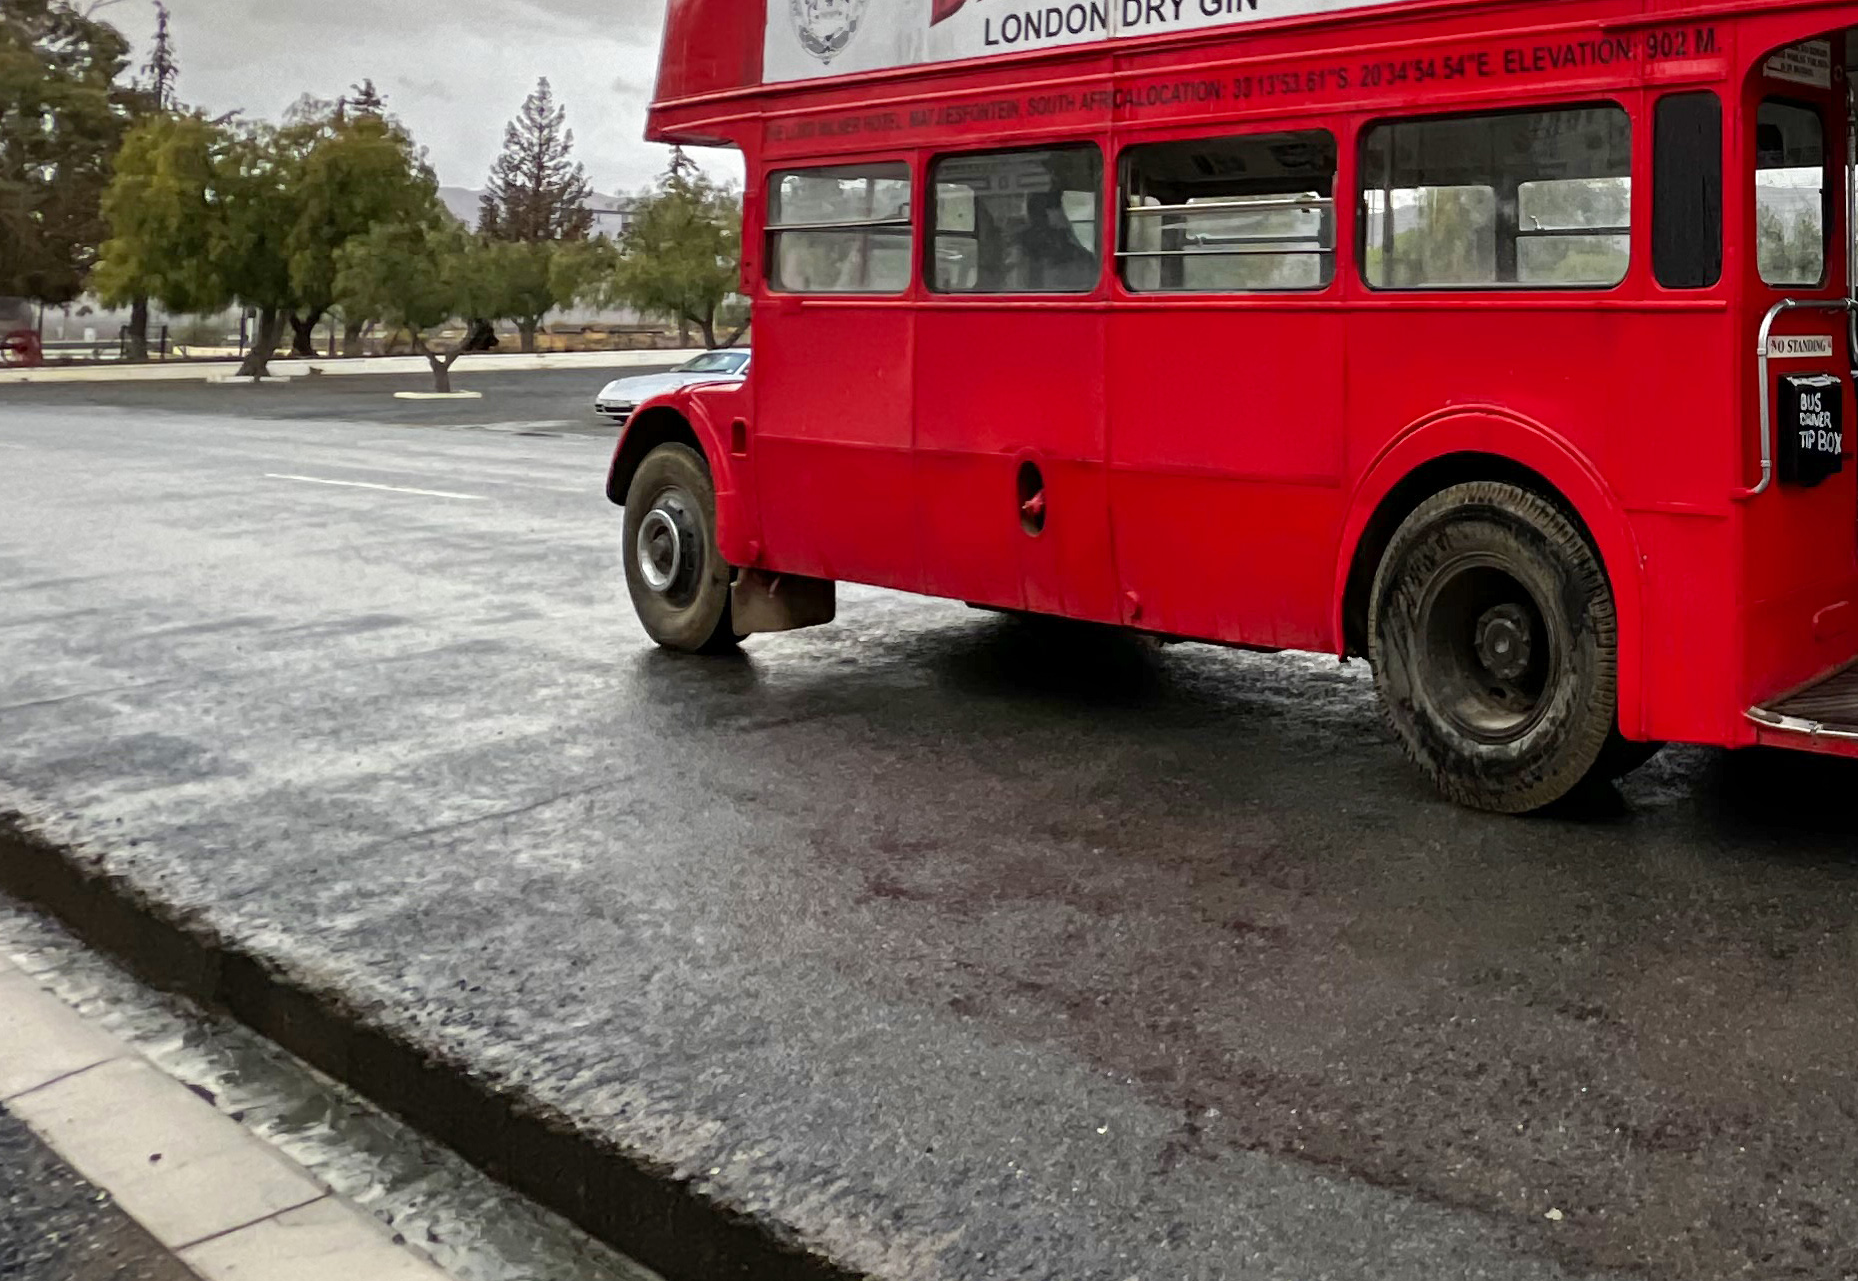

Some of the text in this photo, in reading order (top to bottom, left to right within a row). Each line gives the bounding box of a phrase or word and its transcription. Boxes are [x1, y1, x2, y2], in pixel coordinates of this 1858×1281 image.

[984, 0, 1109, 45] LONDON
[1504, 37, 1637, 74] ELEVATION:
[1646, 30, 1687, 59] 902
[1771, 338, 1826, 354] NO STANDING
[1800, 392, 1822, 412] BUS
[1799, 429, 1843, 455] TIP BOX
